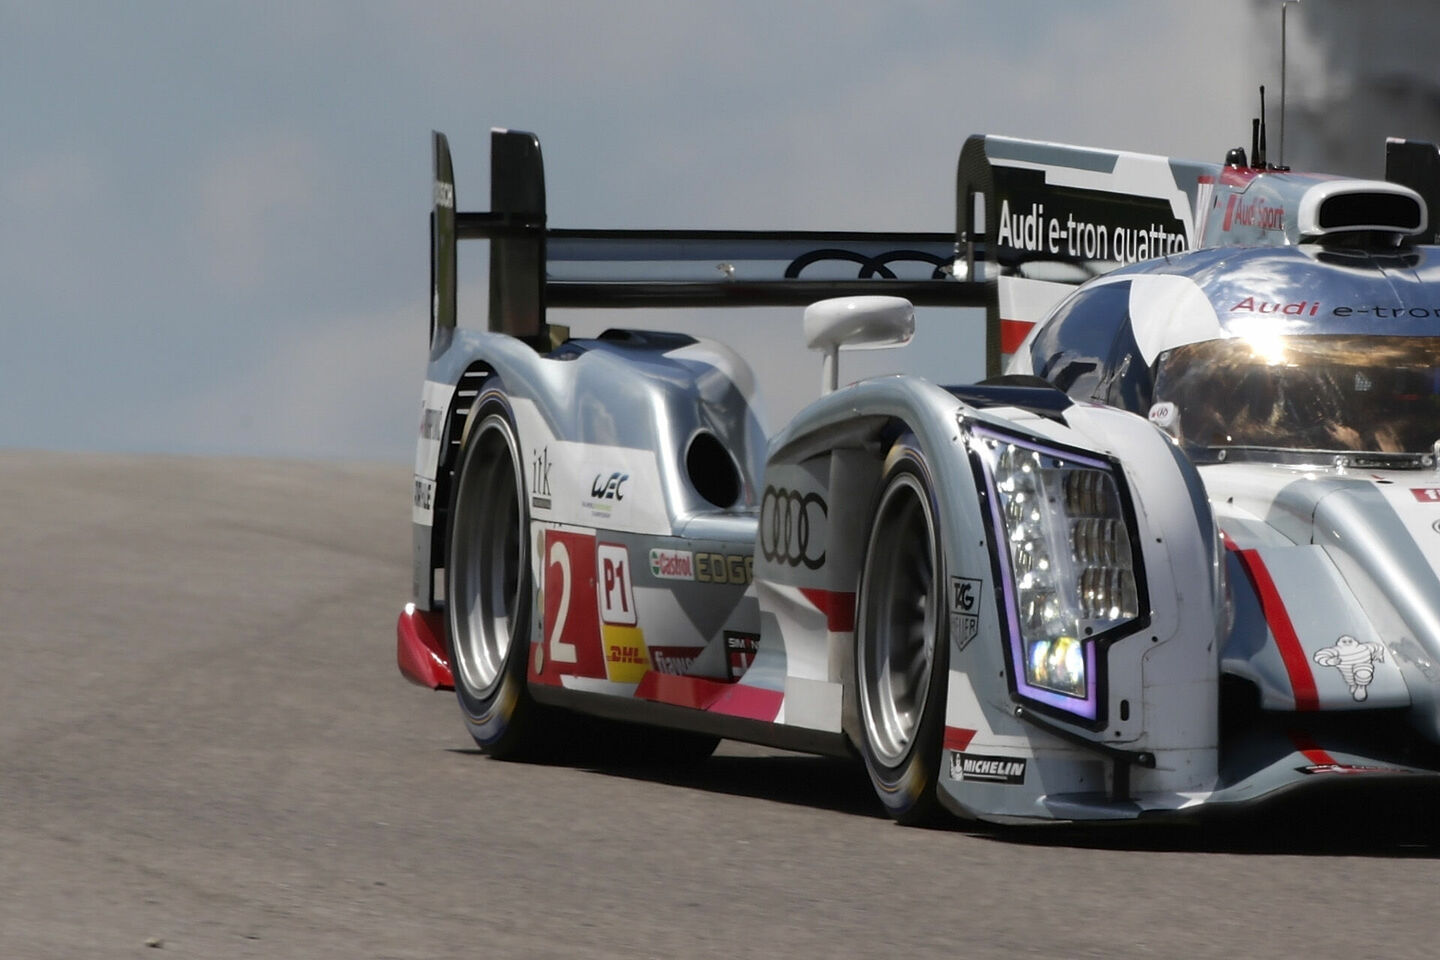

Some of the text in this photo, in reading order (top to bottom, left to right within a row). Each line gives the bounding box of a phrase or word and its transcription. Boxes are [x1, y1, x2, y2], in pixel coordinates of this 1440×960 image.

[998, 199, 1044, 251] Audi
[1049, 213, 1108, 259] e-tron
[1258, 198, 1285, 236] Sport
[1230, 296, 1320, 317] Audi
[532, 445, 552, 496] itk
[591, 471, 630, 501] WEC
[660, 552, 692, 579] Castrol
[603, 558, 628, 613] P1
[954, 583, 974, 611] TAG
[550, 541, 577, 662] 2
[608, 645, 645, 665] DHL
[963, 759, 1025, 776] MICHELIN
